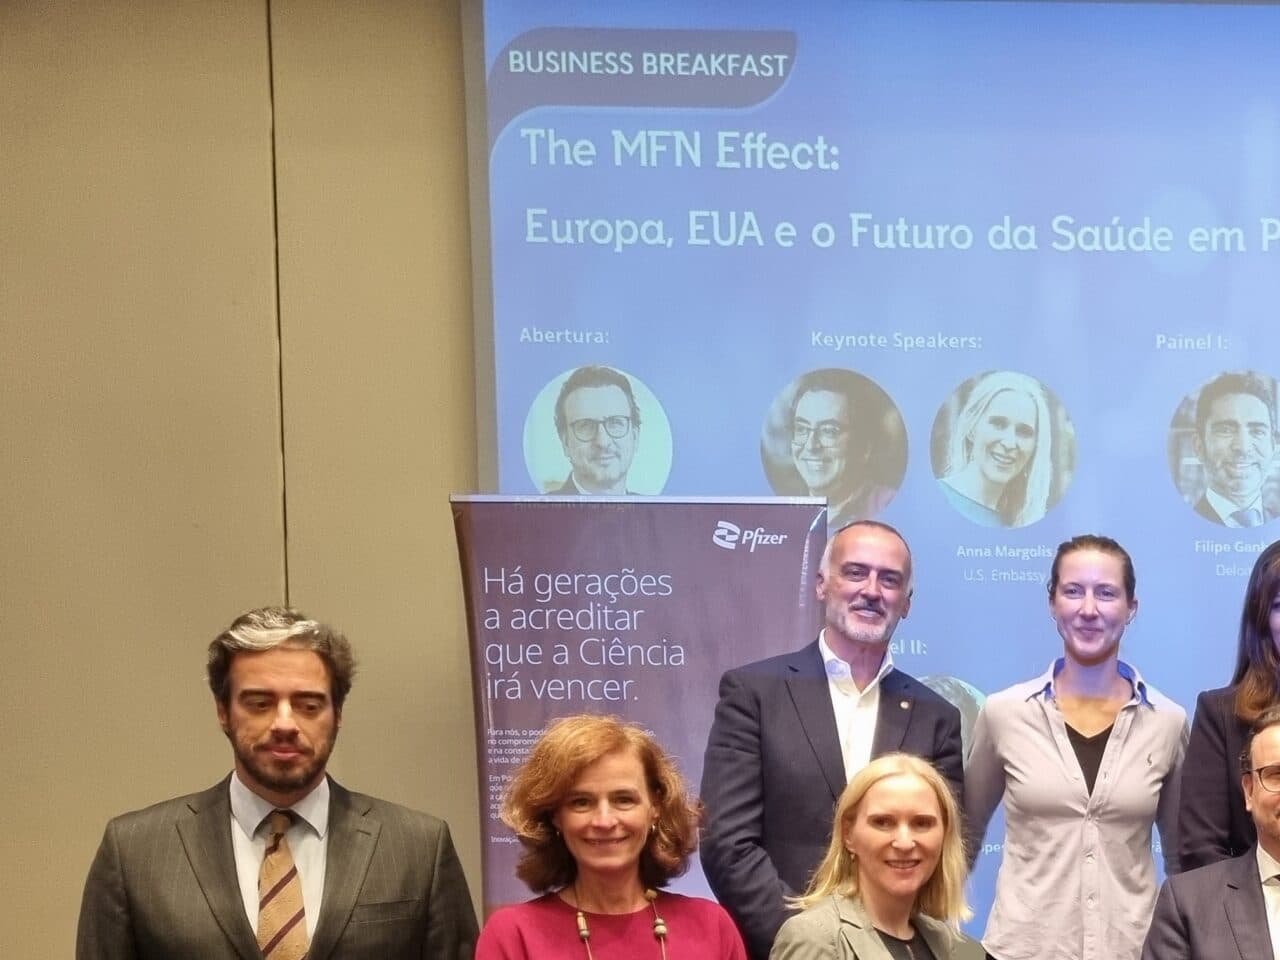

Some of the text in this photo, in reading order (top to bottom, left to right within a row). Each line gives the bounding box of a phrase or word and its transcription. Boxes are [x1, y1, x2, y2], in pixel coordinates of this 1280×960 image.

[509, 50, 788, 77] BUSINESS BREAKFAST
[521, 128, 840, 170] The MFN Effect:
[526, 208, 674, 253] Europa,
[687, 210, 763, 247] EUA
[775, 220, 796, 247] e
[811, 221, 836, 248] o
[849, 213, 973, 249] Futuro
[988, 215, 1038, 250] da
[1051, 215, 1174, 252] Saúde
[1188, 223, 1246, 252] em
[519, 327, 609, 344] Abertura:
[811, 330, 983, 351] Keynote Speakers:
[1156, 333, 1211, 350] Painel
[742, 527, 788, 552] Pfizer
[1195, 540, 1268, 556] Filipe Ganh
[957, 544, 1053, 561] Anna Margolis
[484, 566, 673, 604] Há gerações
[992, 568, 1046, 585] Embassy
[484, 602, 645, 631] a acreditar
[485, 637, 685, 672] que a Ciência
[487, 671, 639, 701] irá vencer.
[498, 738, 538, 747] compromi
